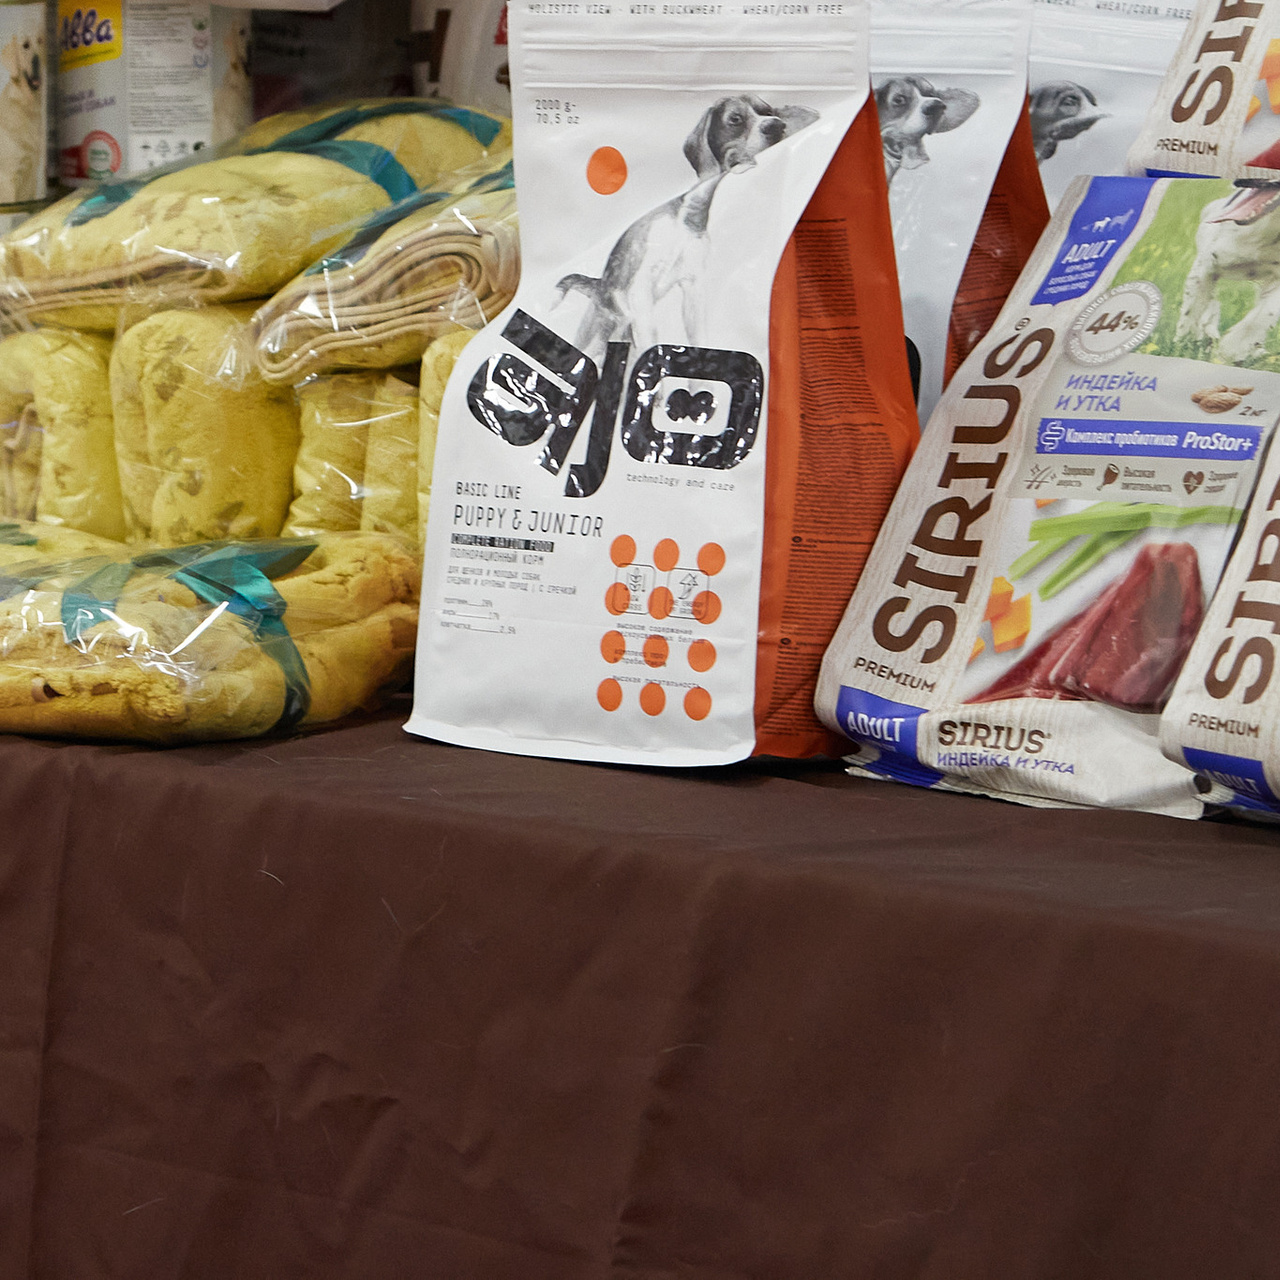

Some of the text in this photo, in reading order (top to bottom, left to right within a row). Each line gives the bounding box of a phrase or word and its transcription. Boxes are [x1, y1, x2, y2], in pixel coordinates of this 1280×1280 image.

[527, 3, 844, 17] HOLISTIC VIEW WITH BUCKWHEAT WHEAT/CORN FREE
[1095, 0, 1160, 17] WHEAT/CORN
[1165, 6, 1194, 20] FREE
[535, 98, 562, 111] 2000
[1154, 136, 1219, 157] PREMIUM
[1061, 239, 1117, 265] ADULT
[1085, 310, 1140, 335] 44%
[1065, 371, 1158, 392] ИНДЕЙКА
[1055, 395, 1122, 413] И УТКА
[1238, 405, 1252, 417] 2
[1065, 427, 1179, 448] Комплекс пробиотиков
[1181, 430, 1254, 452] ProStor+
[455, 481, 522, 500] BASIC LINE
[626, 472, 736, 492] technology and care
[872, 326, 1055, 665] SIRIUS
[453, 503, 604, 538] PUPPY & JUNIOR
[522, 553, 545, 566] КОРМ
[852, 656, 937, 693] PREMIUM
[847, 710, 906, 743] ADULT
[1187, 712, 1261, 739] PREMIUM
[937, 719, 1046, 754] SIRIUS
[936, 749, 1011, 768] ИНДЕЙКА
[1030, 759, 1076, 775] УТКА
